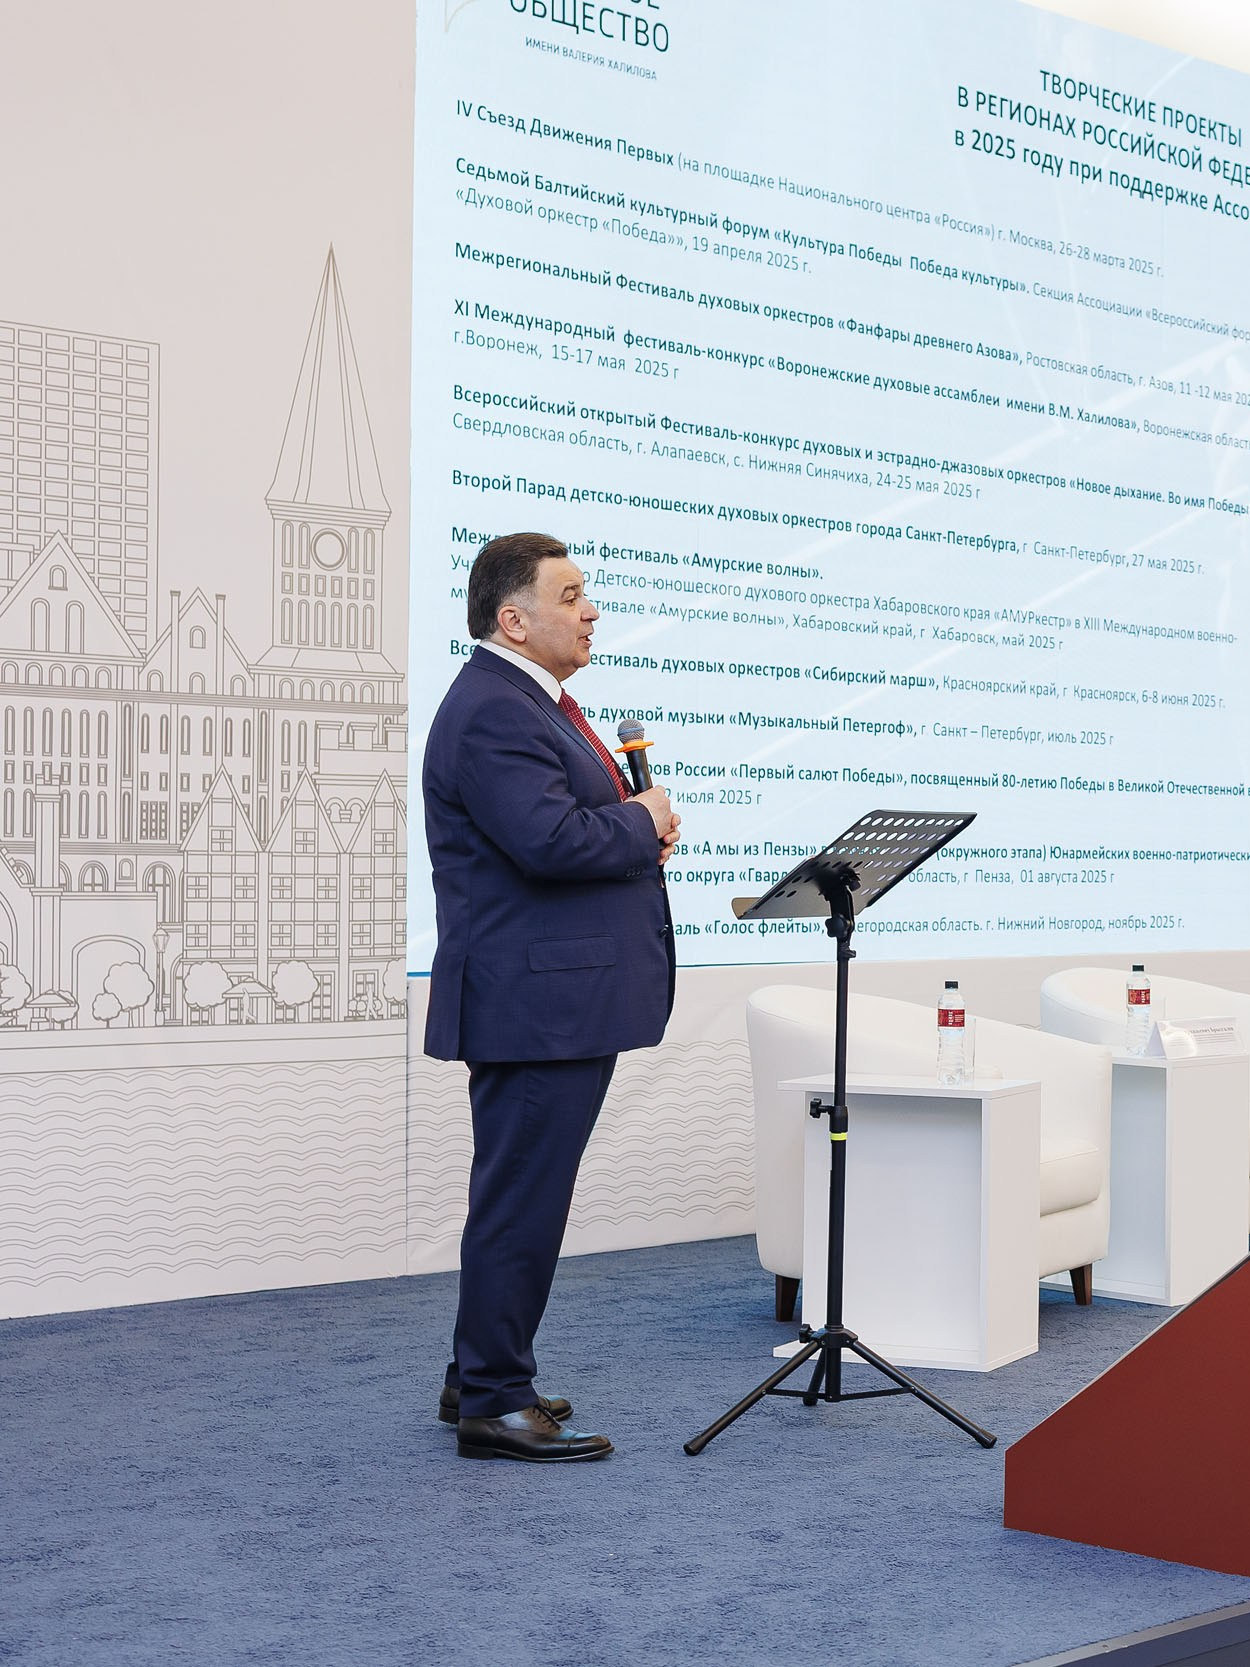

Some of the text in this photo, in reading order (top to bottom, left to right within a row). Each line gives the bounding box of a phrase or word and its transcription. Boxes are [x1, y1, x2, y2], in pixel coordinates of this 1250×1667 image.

[525, 36, 657, 81] ИМЕНИ ВАЛЕРИЯ ХАЛИЛОВА
[457, 99, 674, 167] IV Съезд Движения Первых
[957, 84, 969, 109] В
[976, 90, 1077, 139] РЕГИОНАХ
[1082, 120, 1203, 173] РОССИЙСКОЙ
[1039, 69, 1242, 148] ТВОРЧЕСКИЕ ПРОЕКТЫ
[954, 129, 965, 148] в
[971, 128, 1016, 161] 2025
[1023, 147, 1064, 179] году
[1069, 159, 1103, 186] при
[1109, 170, 1208, 211] поддержке
[455, 186, 799, 272] «Духовой оркестр «Победа»», апреля 2025
[456, 156, 1030, 295] Седьмой Балтийский культурный форум «Культура Победы Победа культуры».
[455, 241, 1023, 366] Межрегиональный Фестиваль духовых оркестров «Фанфары древнего Азова»,
[453, 298, 1141, 434] XI Международный фестиваль-конкурс «Воронежские духовые ассамблеи имени В.М. Халилова»,
[551, 343, 593, 366] 15-17
[597, 354, 626, 372] мая
[634, 357, 669, 379] 2025
[452, 411, 973, 499] Свердловская область, Алапаевск, Нижняя Синячиха, 24-25 мая 2025
[453, 383, 576, 418] Всероссийский
[580, 406, 656, 430] открытый
[660, 415, 800, 452] Фестиваль-конкурс
[802, 439, 862, 459] духовых
[864, 448, 873, 461] и
[876, 450, 1005, 482] эстрадно-джазовых
[1006, 468, 1067, 490] оркестров
[1069, 476, 1112, 496] «Новое
[1113, 485, 1166, 503] дыхание.
[1183, 495, 1205, 509] имя
[452, 469, 1020, 555] Второй Парад детско-юношеских духовых оркестров города Санкт-Петербурга,
[599, 541, 679, 566] фестиваль
[682, 552, 763, 574] «Амурские
[766, 562, 824, 581] волны».
[593, 568, 742, 598] Детско-юношеского
[743, 586, 807, 604] духового
[809, 592, 870, 613] оркестра
[872, 594, 961, 618] Хабаровского
[963, 607, 991, 623] края
[649, 601, 1056, 651] «Амурские волны», Хабаровский край, Хабаровск, май 2025
[589, 651, 1060, 700] естиваль духовых оркестров «Сибирский марш», Красноярский край,
[599, 706, 664, 725] духовой
[667, 710, 725, 728] музыки
[729, 711, 839, 732] «Музыкальный
[842, 716, 917, 738] Петергоф»,
[932, 721, 968, 738] Санкт
[981, 724, 1045, 745] Петербург,
[1079, 730, 1107, 746] 2025
[675, 760, 726, 778] России
[730, 763, 795, 783] «Первый
[798, 768, 839, 782] салют
[842, 766, 908, 788] Победы»,
[910, 772, 999, 790] посвященный
[1001, 773, 1058, 790] 80-летию
[1060, 775, 1106, 795] Победы
[1117, 778, 1165, 794] Великой
[1166, 779, 1245, 797] Отечественной
[676, 791, 714, 805] июля
[718, 788, 752, 806] 2025
[686, 870, 735, 887] округа
[907, 867, 961, 884] область,
[975, 868, 1014, 886] Пенза,
[1037, 871, 1078, 887] августа
[1080, 868, 1107, 884] 2025
[692, 840, 712, 856] «А
[715, 843, 739, 856] мы
[743, 843, 760, 857] из
[762, 841, 819, 857] Пензы»
[1010, 844, 1047, 863] этапа)
[1049, 845, 1130, 861] Юнармейских
[704, 919, 756, 935] «Голос
[757, 919, 827, 940] флейты»,
[931, 915, 983, 933] область.
[997, 915, 1045, 932] Нижний
[1048, 915, 1106, 934] Новгород,
[1149, 914, 1175, 930] 2025
